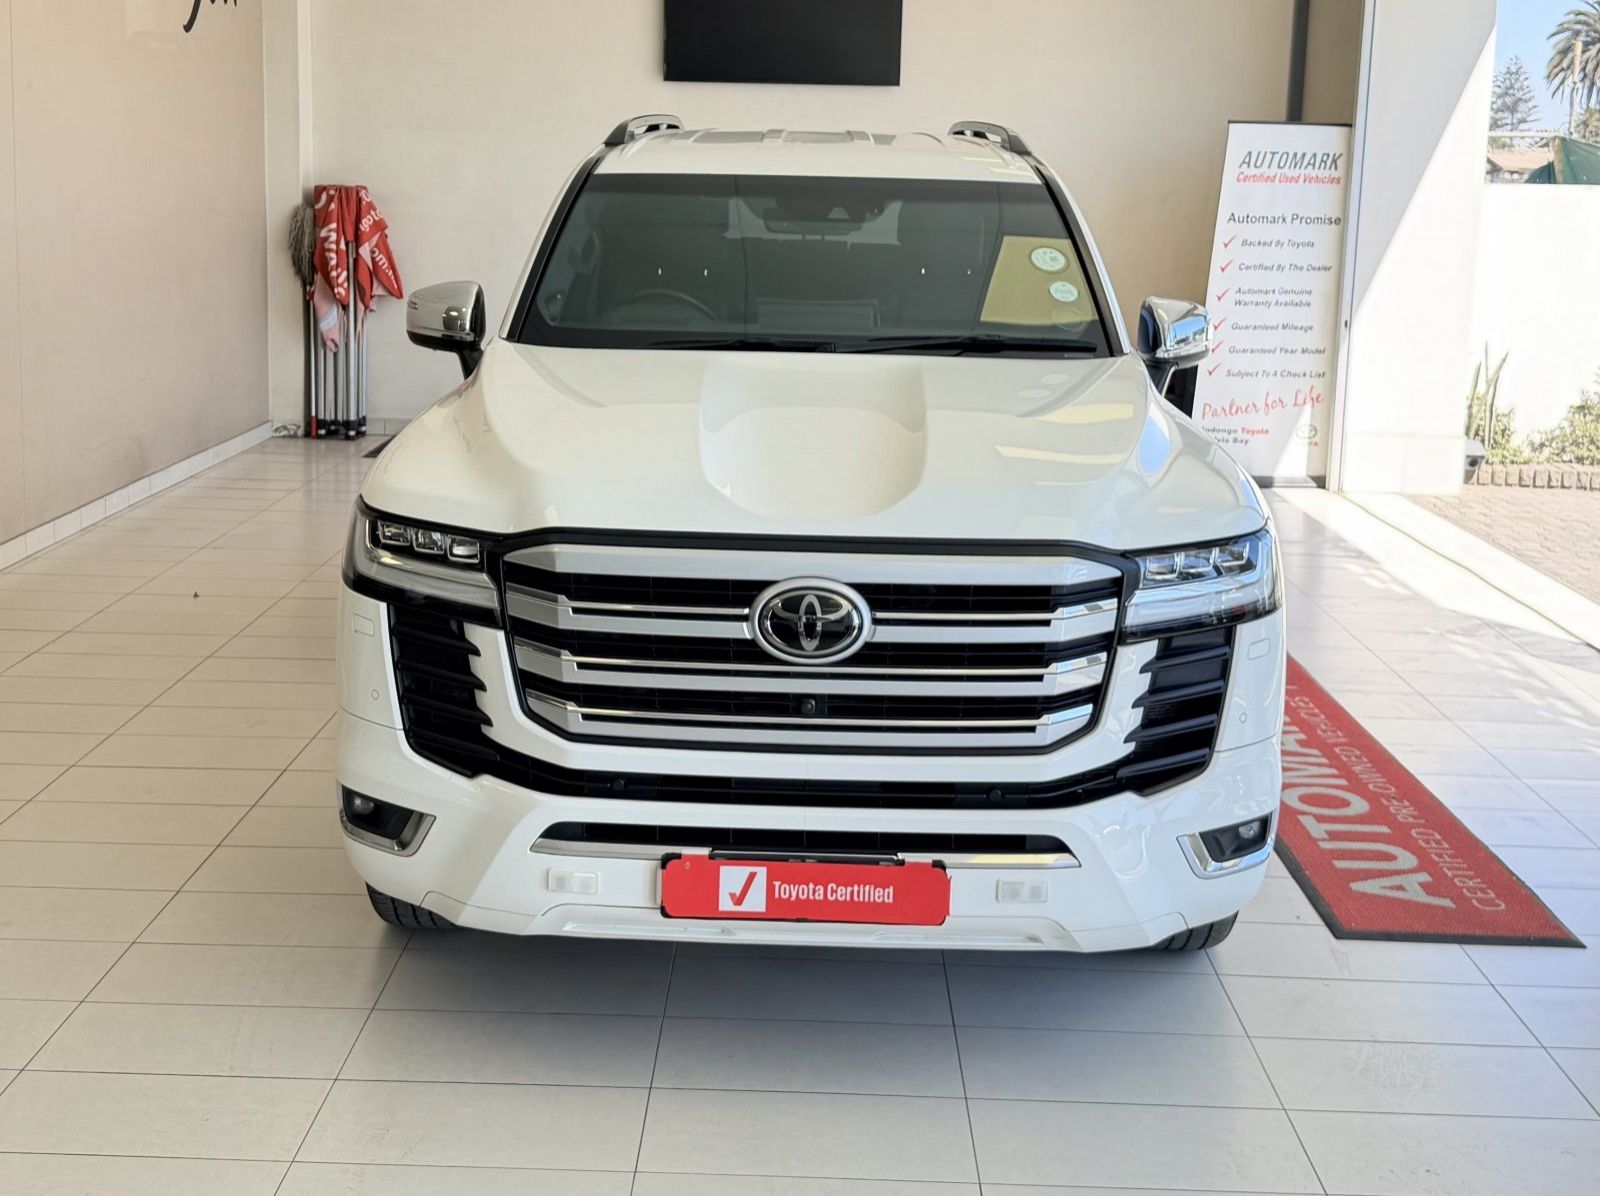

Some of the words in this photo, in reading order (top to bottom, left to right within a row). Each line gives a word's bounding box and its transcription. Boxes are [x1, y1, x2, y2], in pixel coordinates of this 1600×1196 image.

[1238, 150, 1343, 171] AUTOMARK
[1236, 171, 1277, 183] Certified
[1278, 172, 1301, 184] Used
[1303, 173, 1342, 185] Vehicles
[1227, 212, 1287, 225] Automark
[1290, 213, 1342, 226] Promise
[1241, 238, 1273, 248] Backed
[1274, 239, 1285, 249] By
[1287, 239, 1315, 249] Toyota
[1238, 262, 1274, 272] Certified
[1275, 263, 1286, 273] By
[1288, 263, 1304, 272] The
[1306, 263, 1332, 272] Dealer
[1235, 287, 1276, 296] Automark
[1278, 287, 1313, 296] Genuine
[1234, 298, 1273, 309] Warranty
[1274, 299, 1311, 308] Available
[1231, 322, 1279, 332] Guaranteed
[1281, 322, 1313, 333] Mileage
[1228, 345, 1277, 355] Guaranteed
[1279, 346, 1299, 355] Year
[1301, 346, 1326, 355] Model
[1226, 368, 1259, 379] Subject
[1261, 369, 1271, 379] To
[1280, 369, 1307, 379] Check
[1309, 369, 1326, 379] List
[1202, 398, 1260, 421] Partner
[1263, 390, 1288, 417] for
[1292, 384, 1326, 408] Life
[1241, 427, 1269, 436] Toyota
[1333, 746, 1425, 824] PRE-OWNED
[1410, 827, 1506, 910] CERTIFIED
[773, 880, 824, 901] Toyota
[827, 883, 894, 903] Certified
